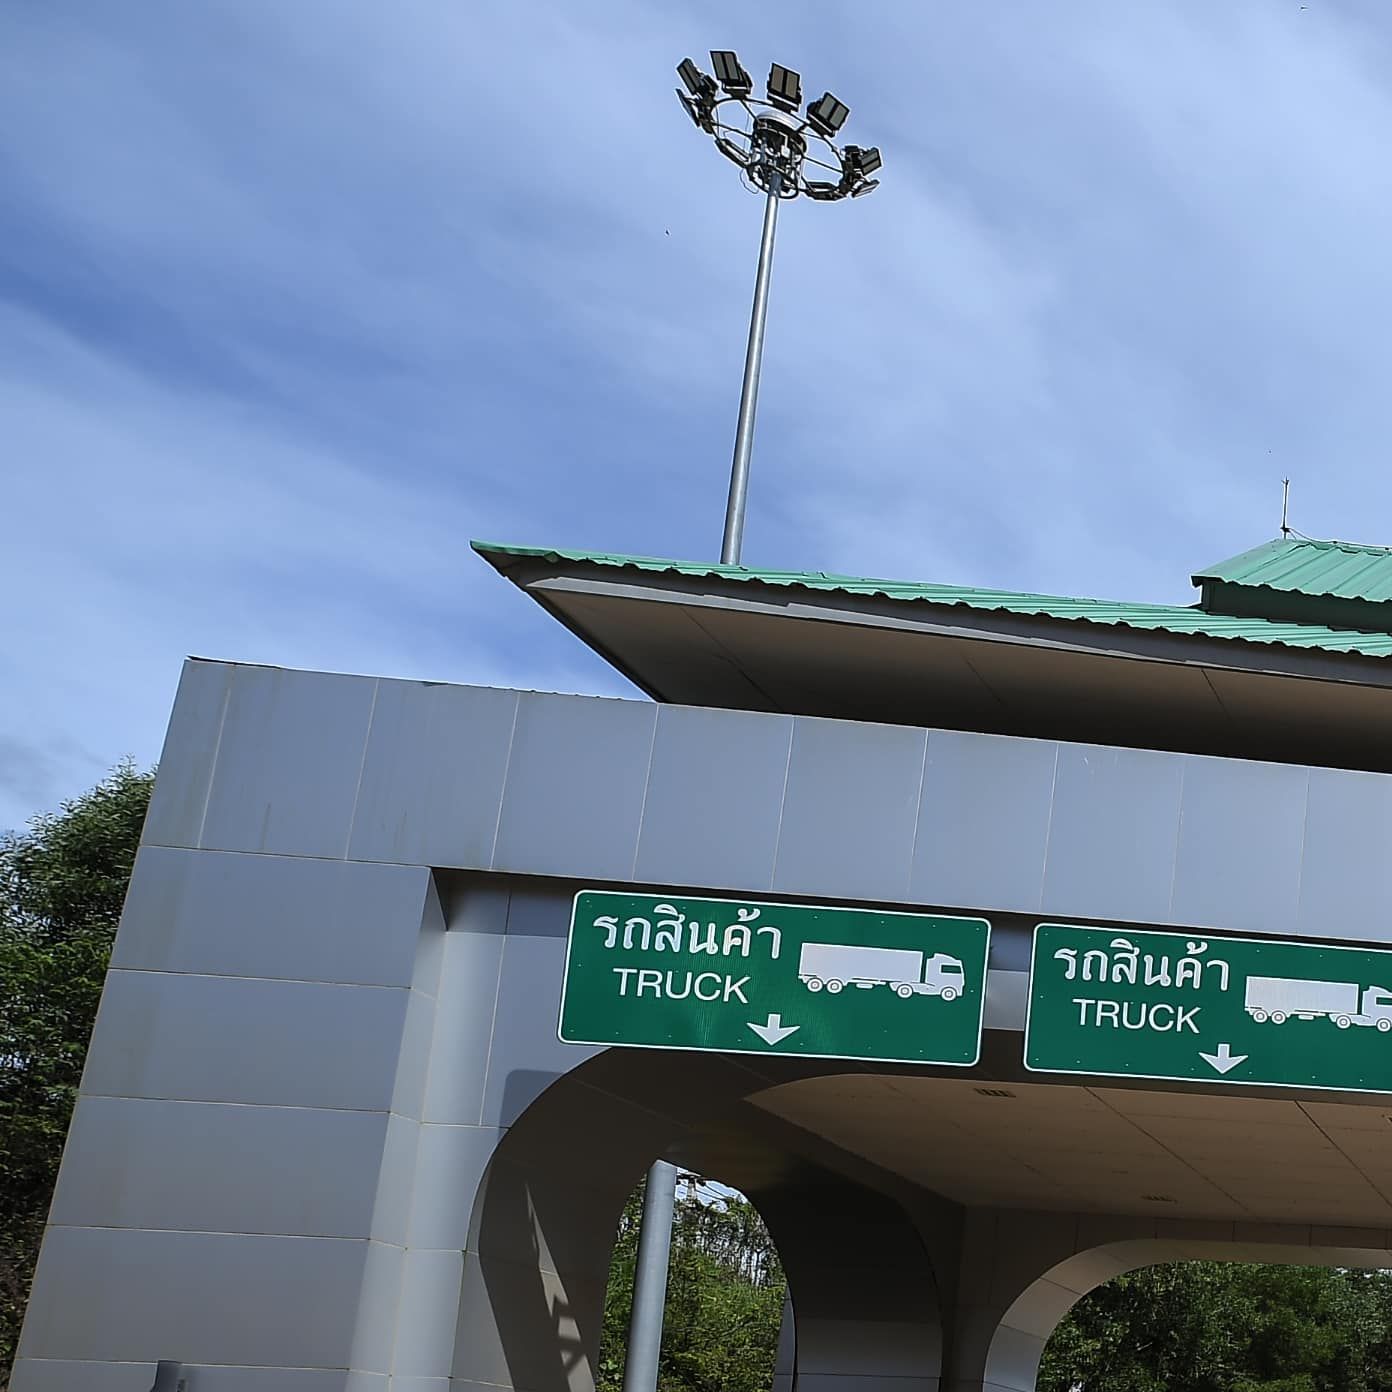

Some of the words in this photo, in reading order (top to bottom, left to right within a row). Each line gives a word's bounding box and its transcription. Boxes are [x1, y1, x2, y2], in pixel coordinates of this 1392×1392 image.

[593, 903, 782, 959] รถสินค้า
[612, 967, 751, 1004] TRUCK
[1053, 938, 1229, 991] รถสินค้า
[1072, 998, 1201, 1034] TRUCK
